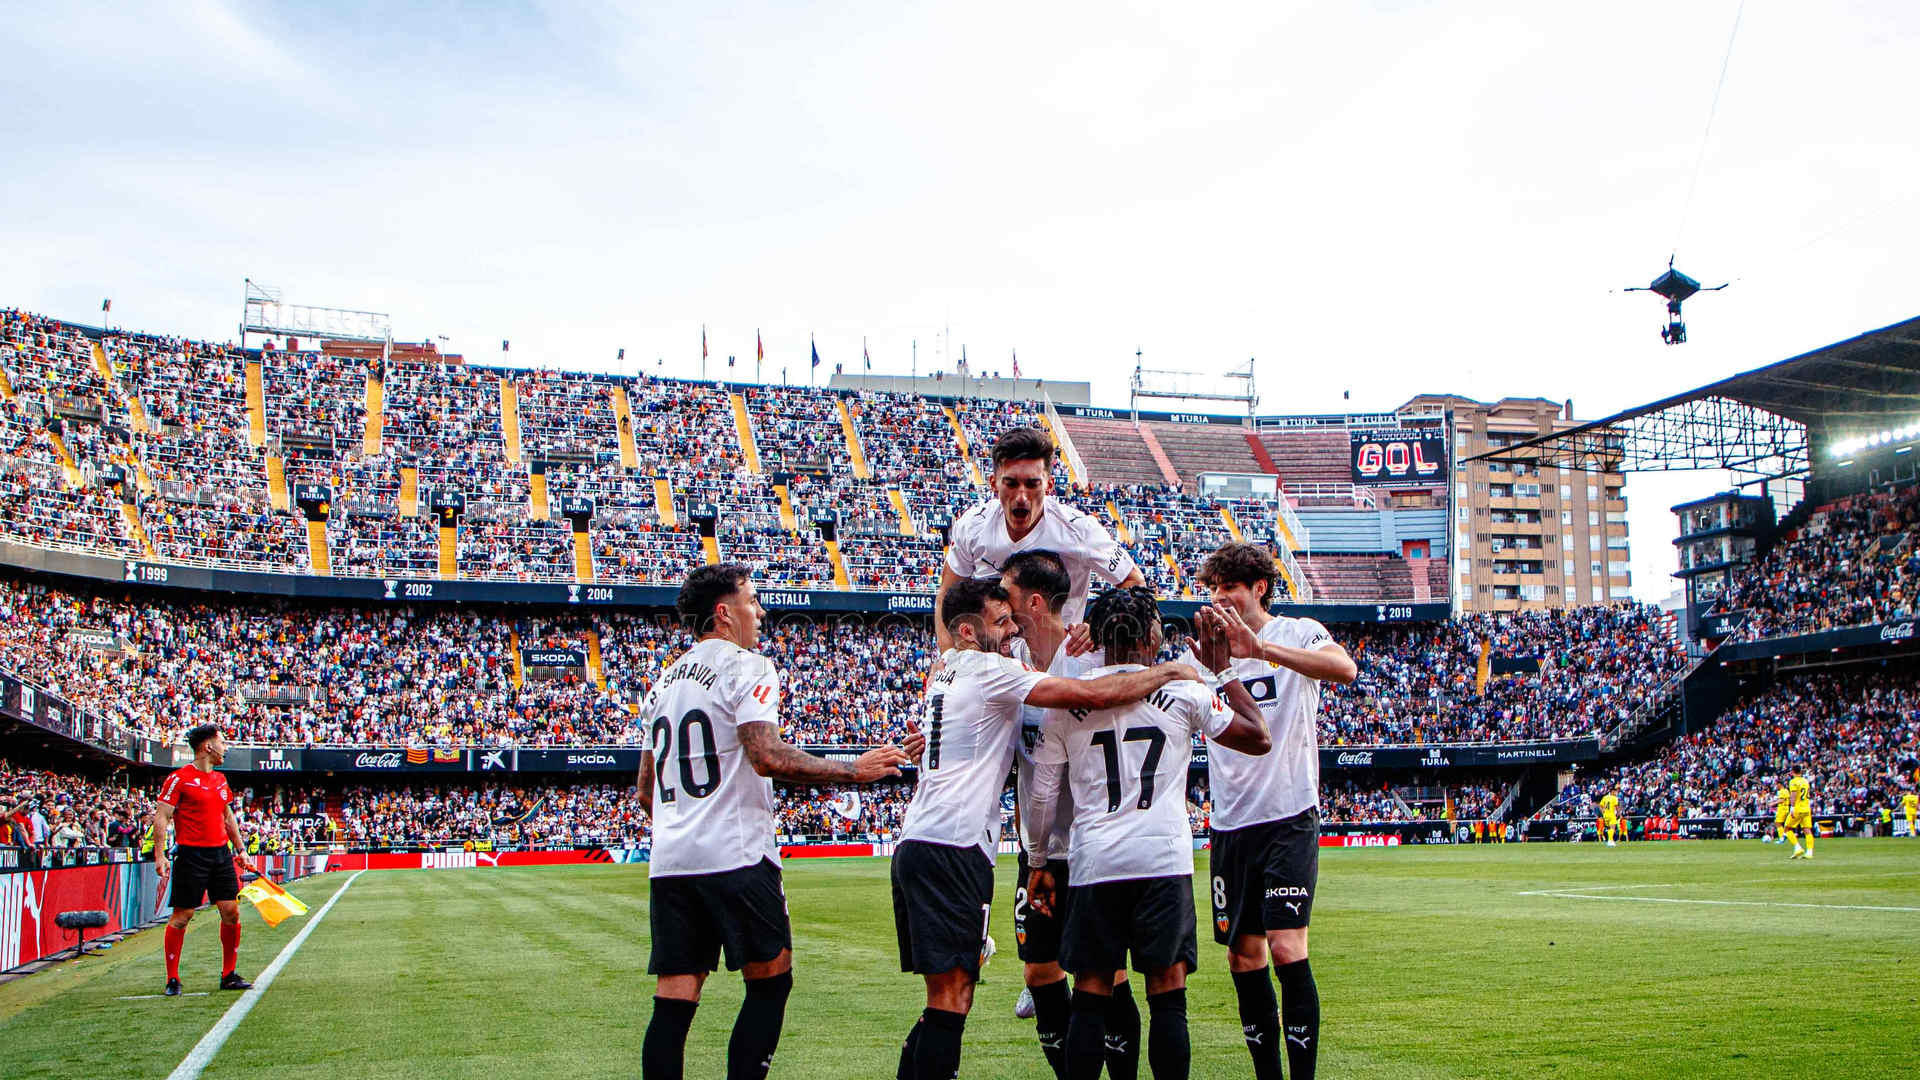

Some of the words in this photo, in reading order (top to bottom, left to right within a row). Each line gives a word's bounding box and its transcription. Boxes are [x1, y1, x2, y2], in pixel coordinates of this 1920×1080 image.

[1085, 408, 1114, 418] TURIA
[1179, 414, 1208, 424] TURIA
[1288, 418, 1318, 426] TURIA
[1357, 442, 1438, 472] GOL
[301, 491, 325, 500] TURIA
[436, 498, 459, 507] TURIA
[566, 504, 588, 512] TURIA
[692, 509, 712, 517] TURIA
[811, 513, 833, 521] TURIA
[140, 566, 168, 582] 1999
[405, 583, 433, 597] 2002
[587, 587, 613, 602] 2004
[760, 592, 811, 606] MESTALLA
[888, 595, 932, 610] ¡GRACIAS
[1389, 606, 1412, 619] 2019
[663, 662, 718, 691] SARAVIA
[652, 708, 721, 804] 20
[1497, 748, 1557, 760] MARTINELLI
[259, 760, 293, 770] TURIA
[1421, 756, 1450, 766] TURIA
[1090, 726, 1166, 813] 17
[1344, 836, 1385, 847] LALIGA
[1425, 837, 1450, 845] TURIA
[1213, 875, 1227, 910] 8
